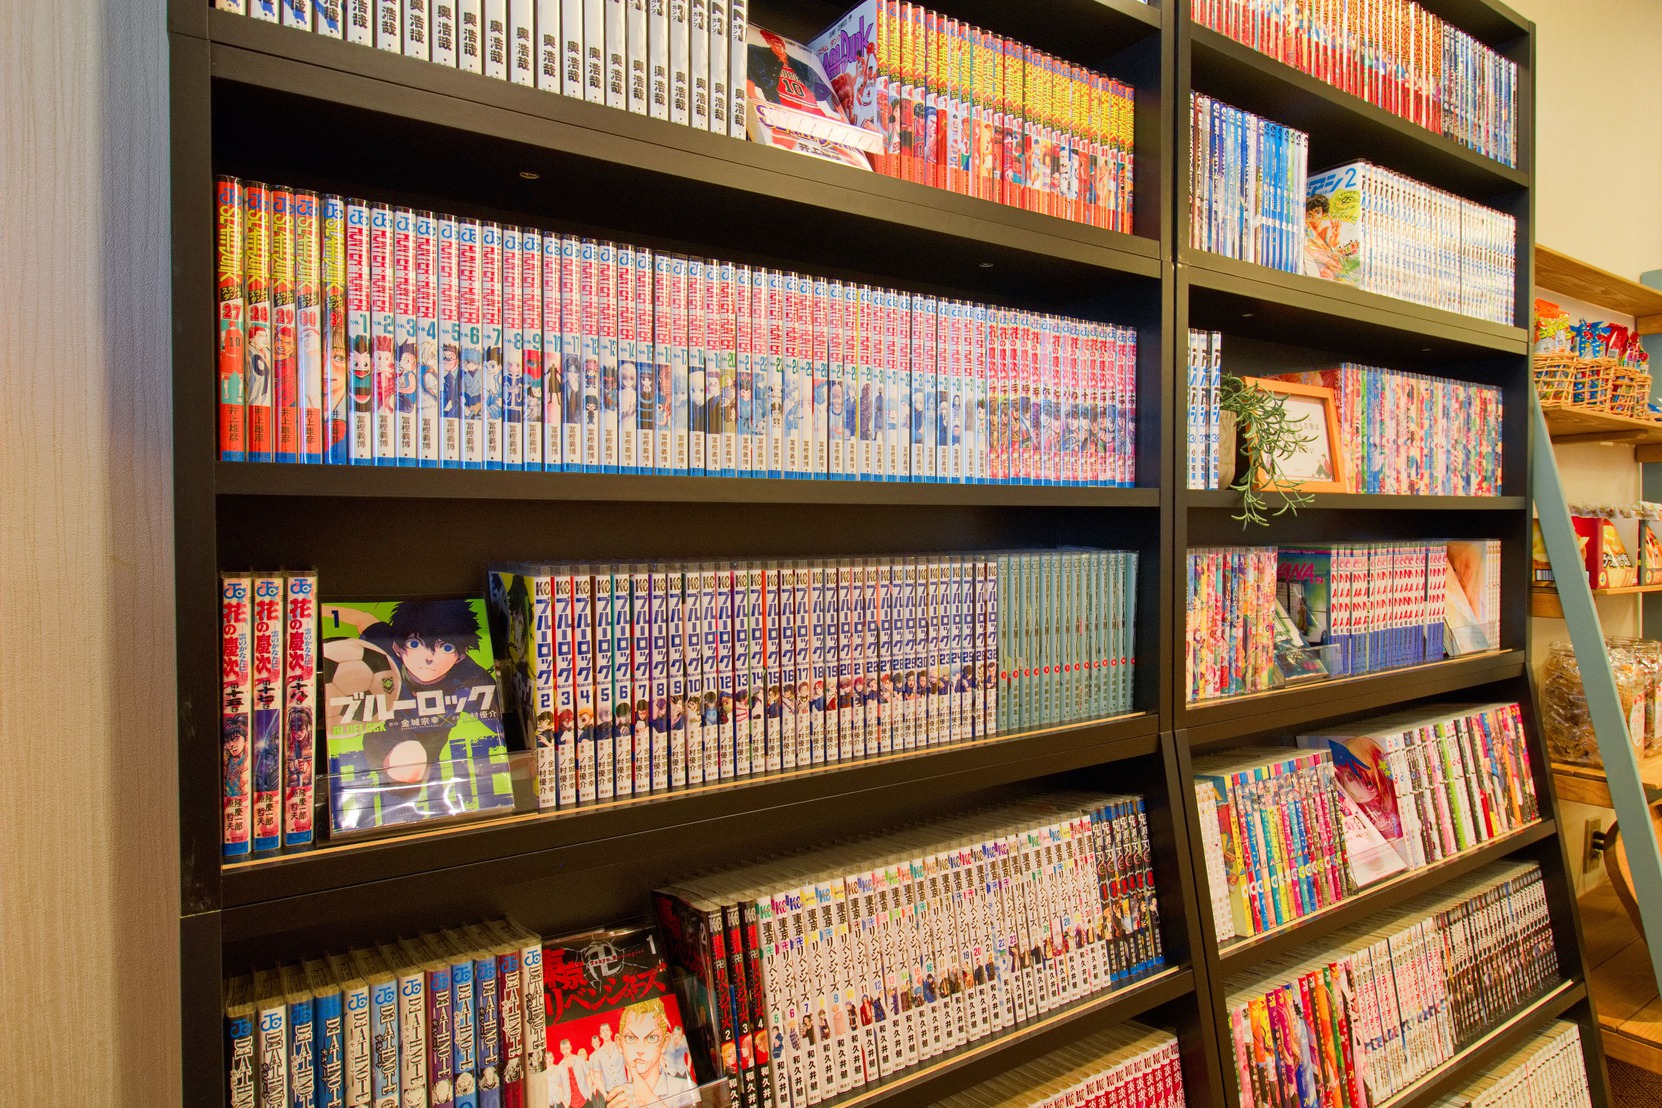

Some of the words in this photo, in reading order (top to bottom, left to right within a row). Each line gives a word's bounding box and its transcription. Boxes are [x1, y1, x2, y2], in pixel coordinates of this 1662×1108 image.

[438, 5, 452, 51] 奥浩哉
[464, 12, 477, 57] 奥浩哉
[782, 79, 805, 97] 10
[1345, 168, 1356, 188] 2
[222, 304, 241, 320] 27
[251, 306, 268, 322] 28
[276, 308, 294, 324] 29
[300, 309, 317, 326] 30
[330, 312, 344, 327] 31
[332, 610, 339, 628] 1
[224, 602, 247, 678] 花の慶次
[256, 600, 279, 675] 花の慶次
[289, 598, 312, 671] 花の慶次
[536, 597, 552, 685] ブルーロック
[556, 596, 572, 683] ブルーロック
[576, 595, 591, 681] ブルーロック
[598, 595, 611, 679] ブルーロック
[616, 594, 630, 677] ブルーロック
[706, 677, 716, 690] 11
[720, 676, 731, 689] 12
[737, 674, 748, 686] 13
[752, 672, 763, 684] 14
[768, 671, 778, 684] 15
[620, 685, 627, 699] 6
[639, 685, 646, 698] 7
[657, 683, 664, 696] 8
[674, 681, 682, 694] 9
[689, 679, 700, 692] 10
[541, 694, 550, 708] 2
[562, 691, 570, 705] 3
[581, 690, 590, 703] 4
[601, 688, 609, 701] 5
[330, 685, 496, 724] ブルーロック
[401, 717, 439, 728] 金城宗幸
[647, 934, 656, 954] 1
[774, 1014, 779, 1023] 5
[789, 1009, 794, 1018] 6
[743, 1022, 748, 1033] 3
[758, 1019, 763, 1028] 4
[725, 1030, 731, 1040] 2
